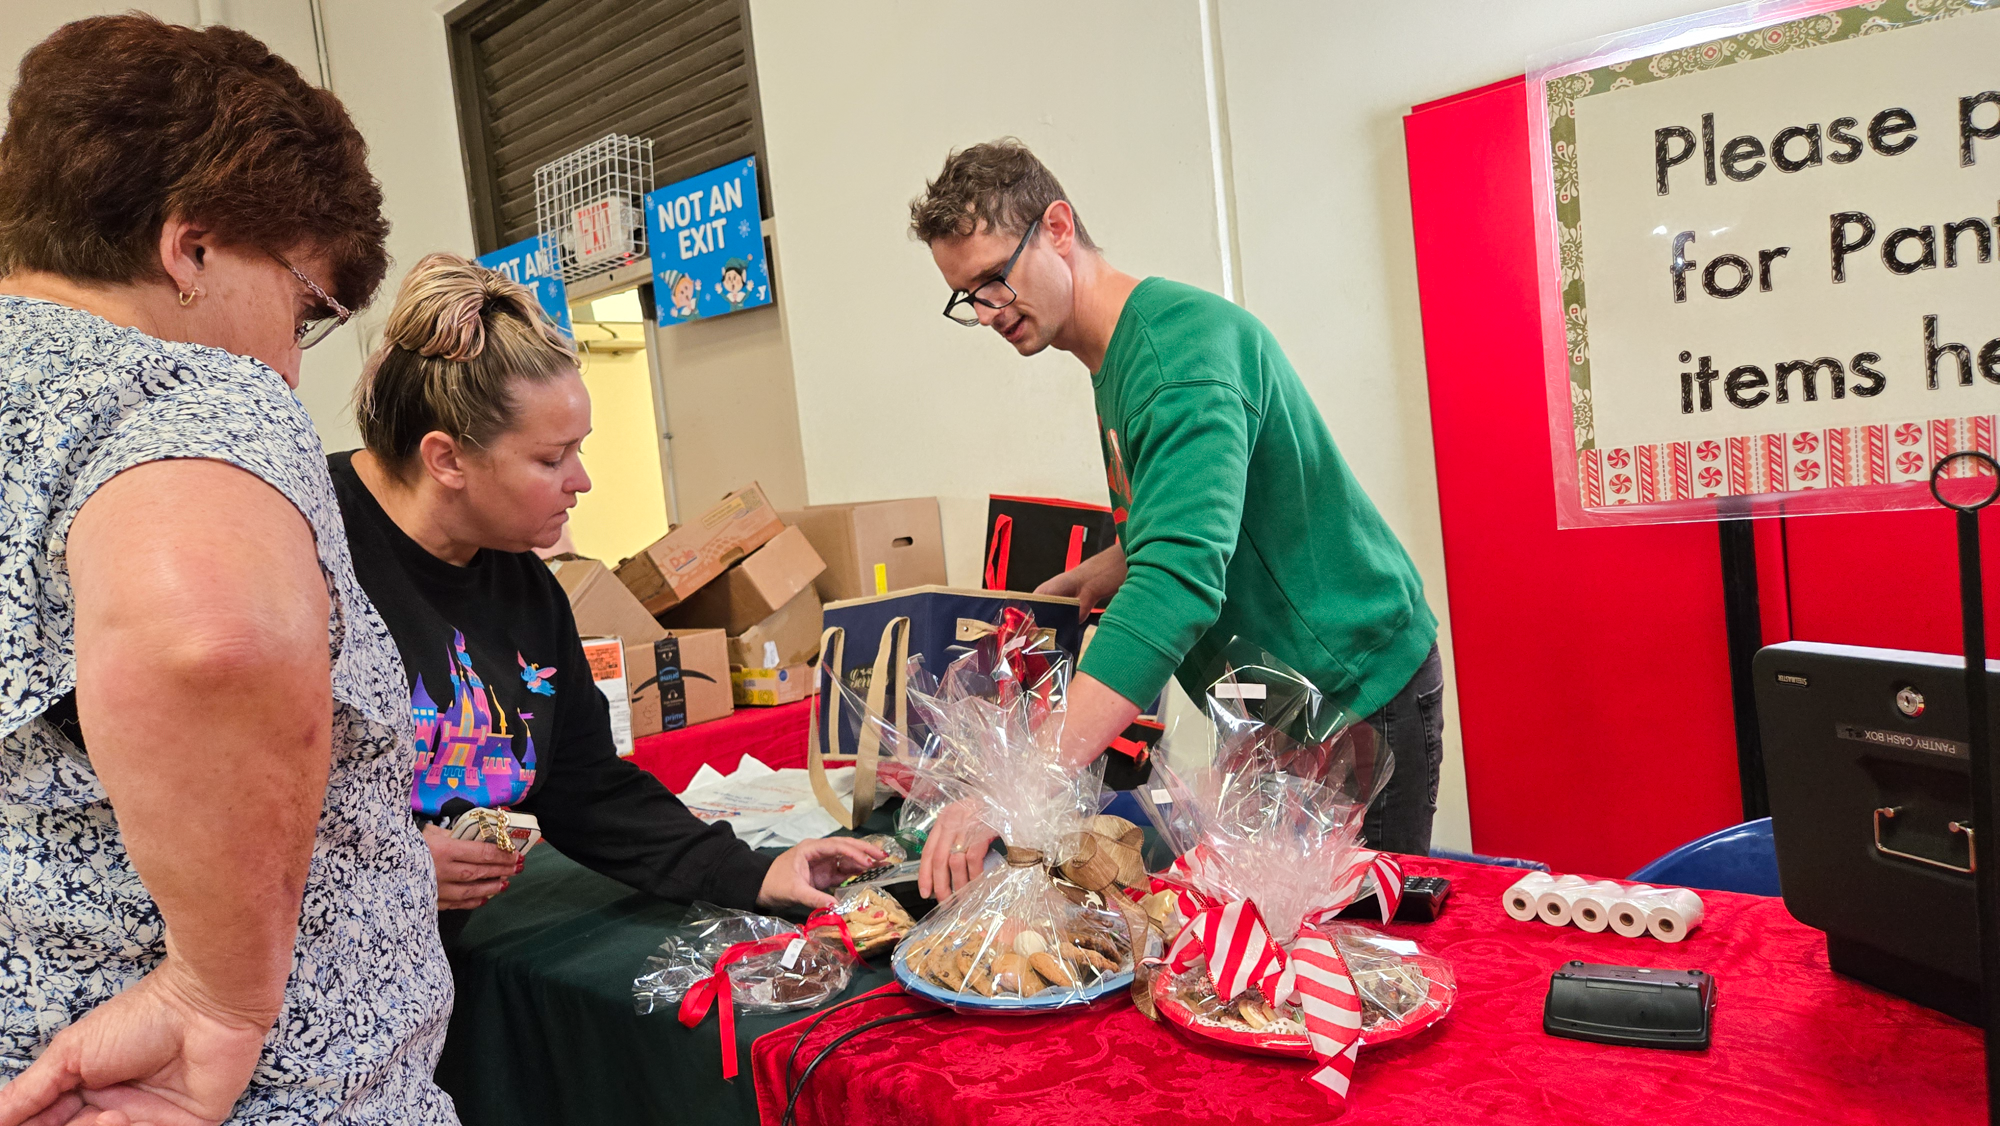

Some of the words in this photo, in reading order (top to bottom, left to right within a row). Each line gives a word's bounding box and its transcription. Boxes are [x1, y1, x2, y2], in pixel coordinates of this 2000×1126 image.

[1654, 107, 1919, 197] Please
[577, 201, 613, 256] EXIT
[658, 190, 704, 233] NOT
[708, 177, 744, 218] AN
[678, 217, 728, 261] EXIT
[1670, 231, 1790, 304] for
[1679, 350, 1887, 415] items
[664, 712, 684, 723] prime
[1864, 729, 1885, 743] BOX
[1885, 732, 1914, 747] CASH
[1913, 738, 1956, 754] PANTRY
